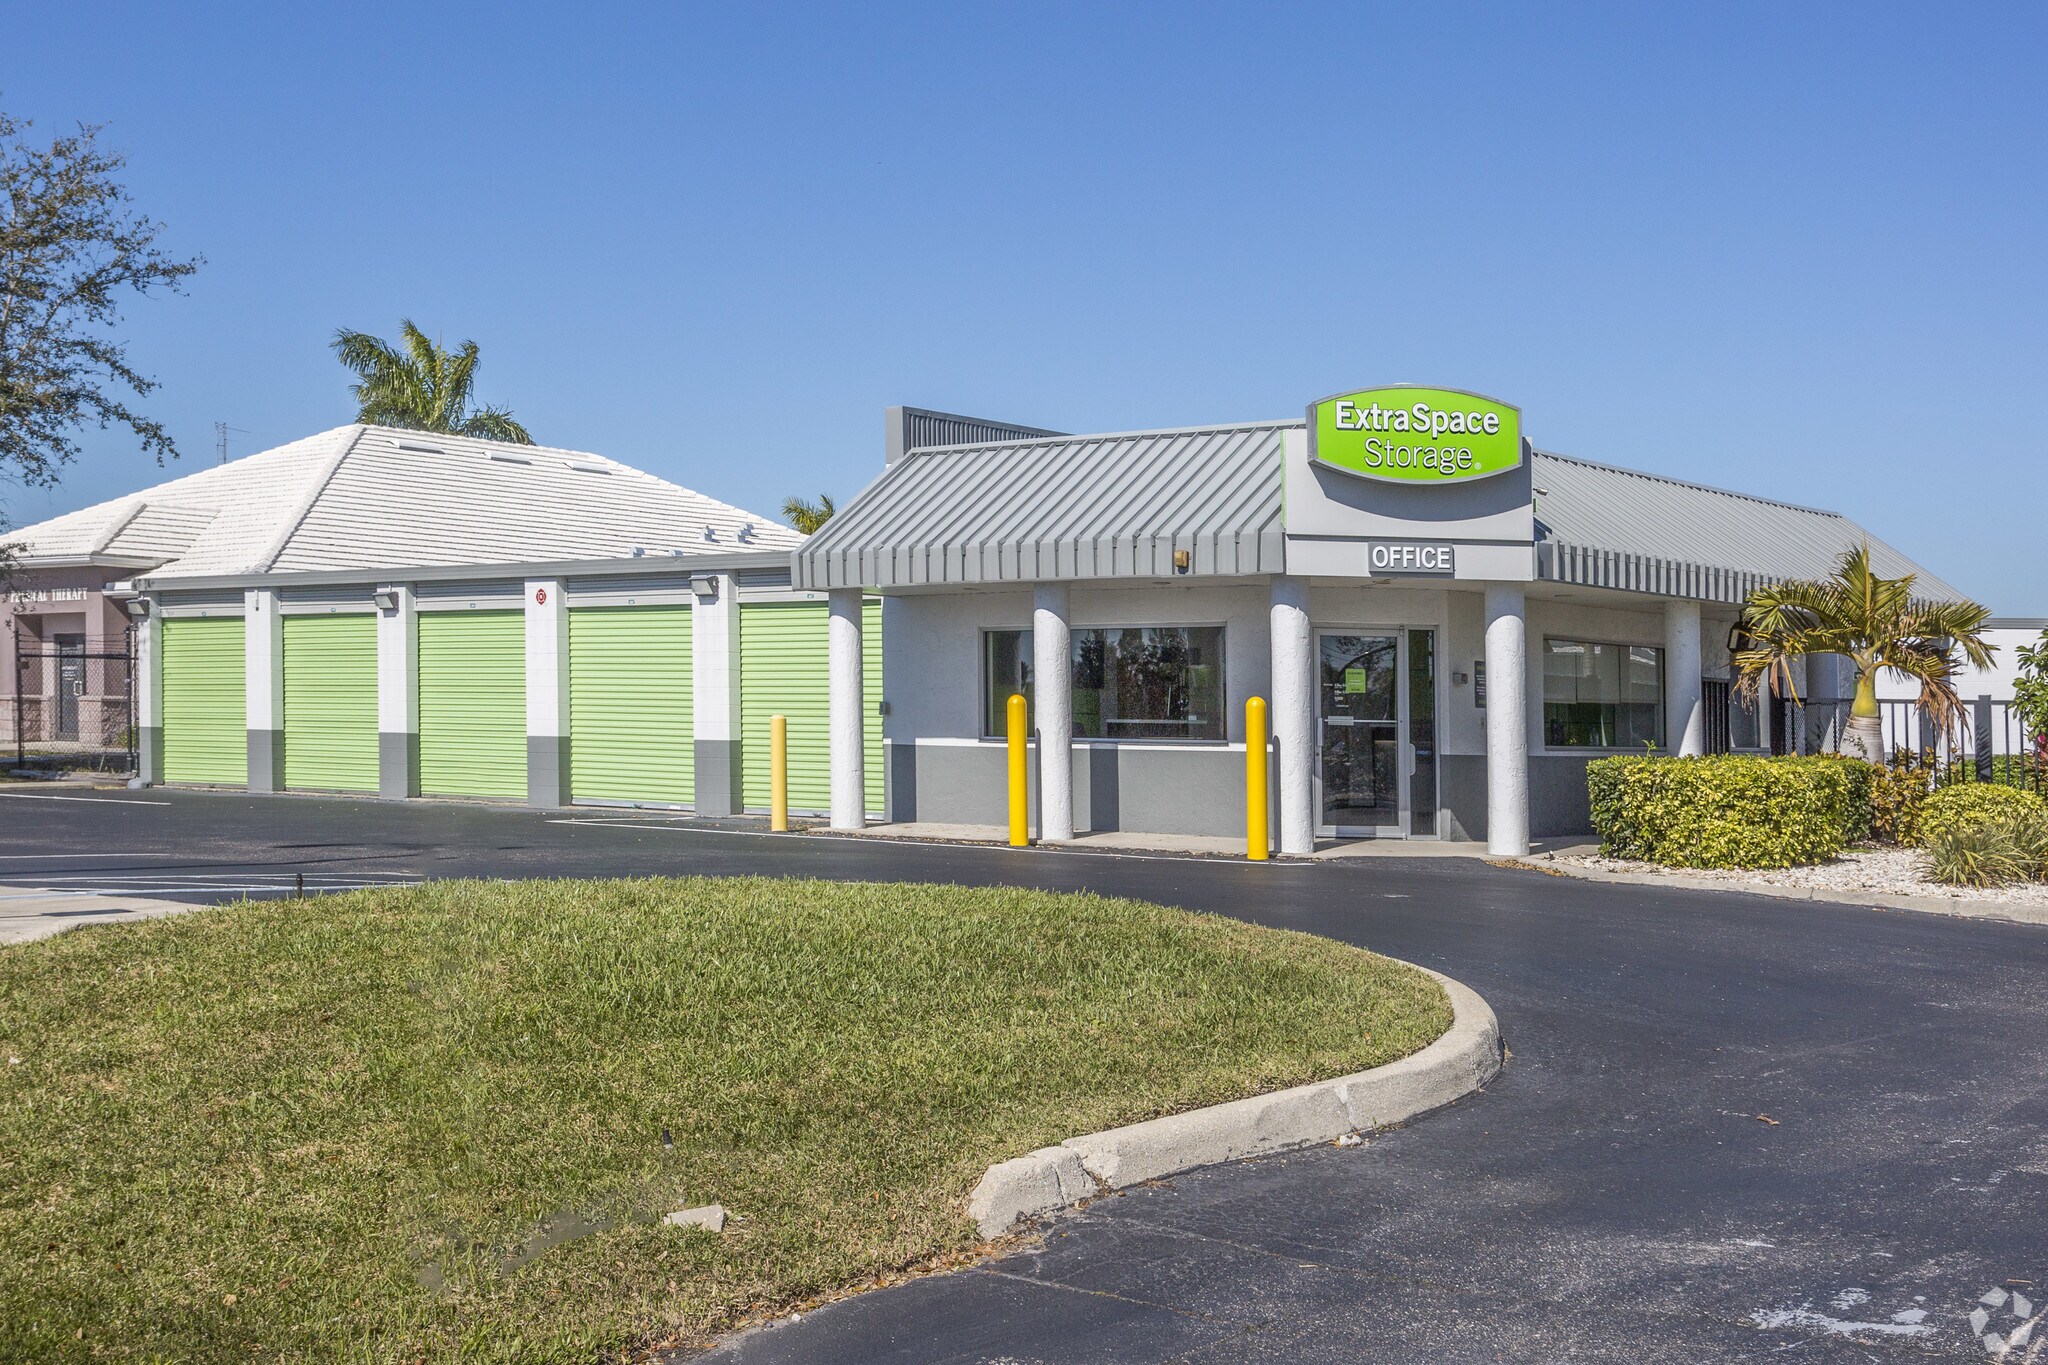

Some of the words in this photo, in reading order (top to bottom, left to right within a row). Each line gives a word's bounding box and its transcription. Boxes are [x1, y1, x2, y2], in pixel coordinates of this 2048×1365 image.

[1364, 438, 1473, 474] Storage
[1372, 546, 1451, 569] OFFICE
[51, 588, 87, 601] THERAPY
